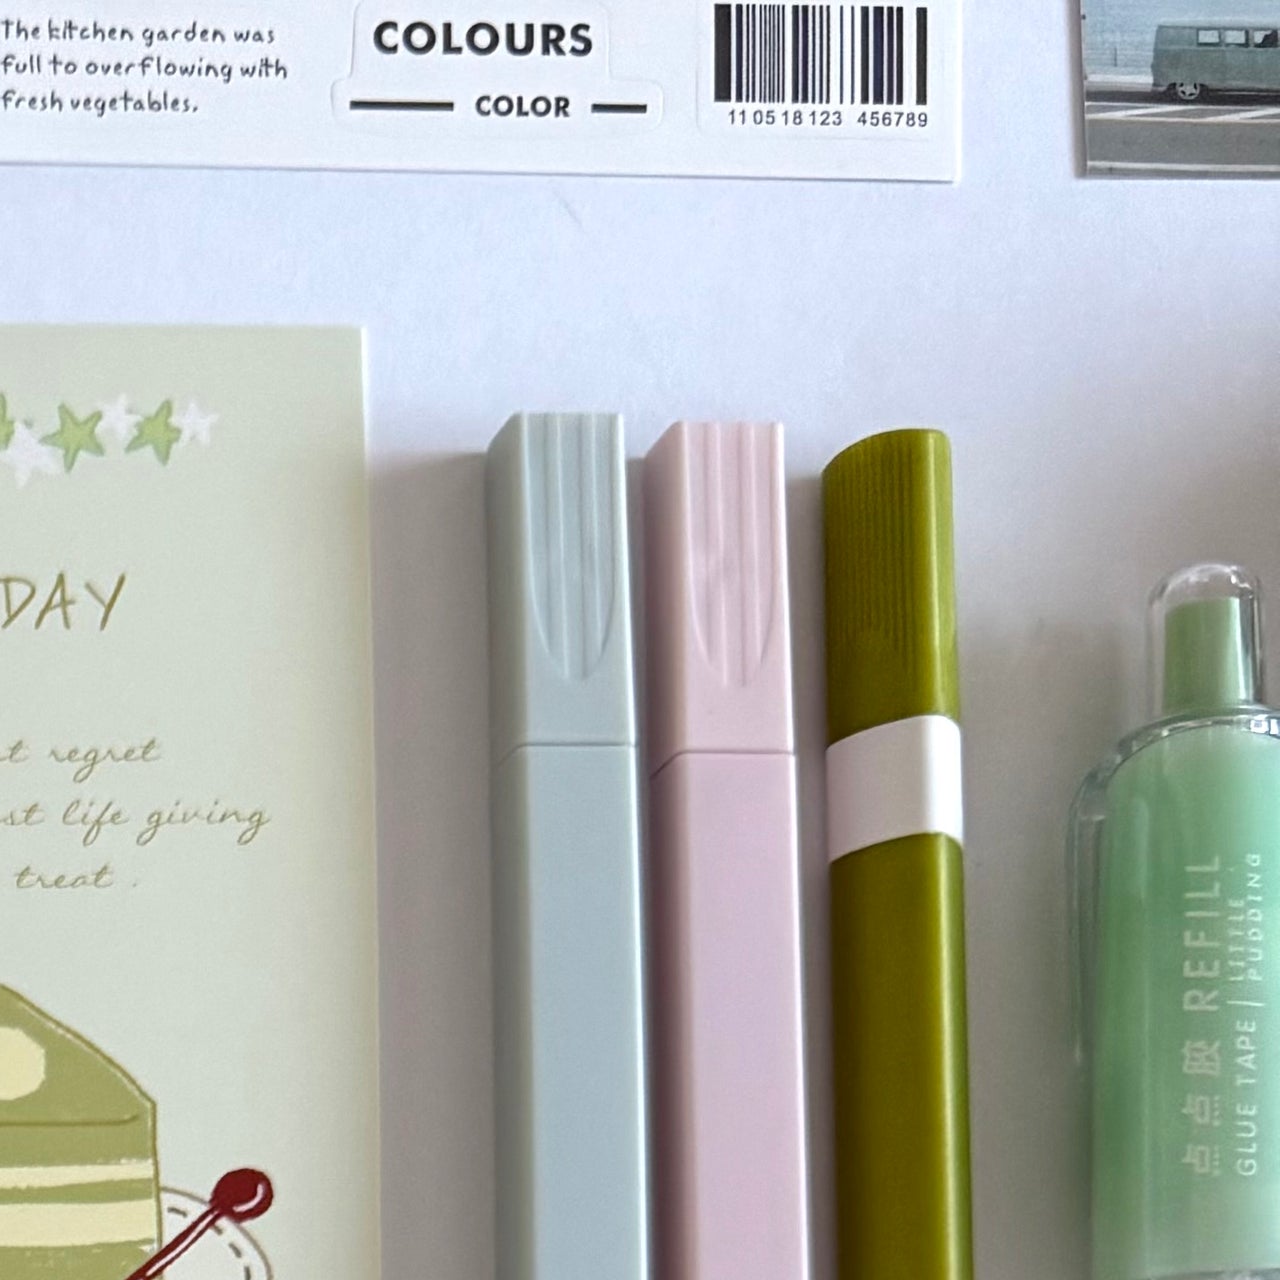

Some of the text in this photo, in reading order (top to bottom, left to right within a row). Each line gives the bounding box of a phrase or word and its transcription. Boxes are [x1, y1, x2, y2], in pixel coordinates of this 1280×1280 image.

[0, 19, 275, 47] The kitchen garden was
[373, 21, 593, 57] COLOURS
[0, 54, 288, 84] full to overflowing with
[0, 89, 63, 112] fresh
[475, 96, 570, 118] COLOR
[857, 111, 929, 128] 456789
[47, 738, 162, 783] regret
[61, 799, 130, 847] life
[135, 801, 272, 847] giving
[15, 863, 114, 889] treat
[1182, 855, 1221, 1012] REFILL
[1246, 852, 1264, 982] PUDDING
[1227, 898, 1245, 982] LITTLE
[1234, 1019, 1258, 1177] GLUE TAPE
